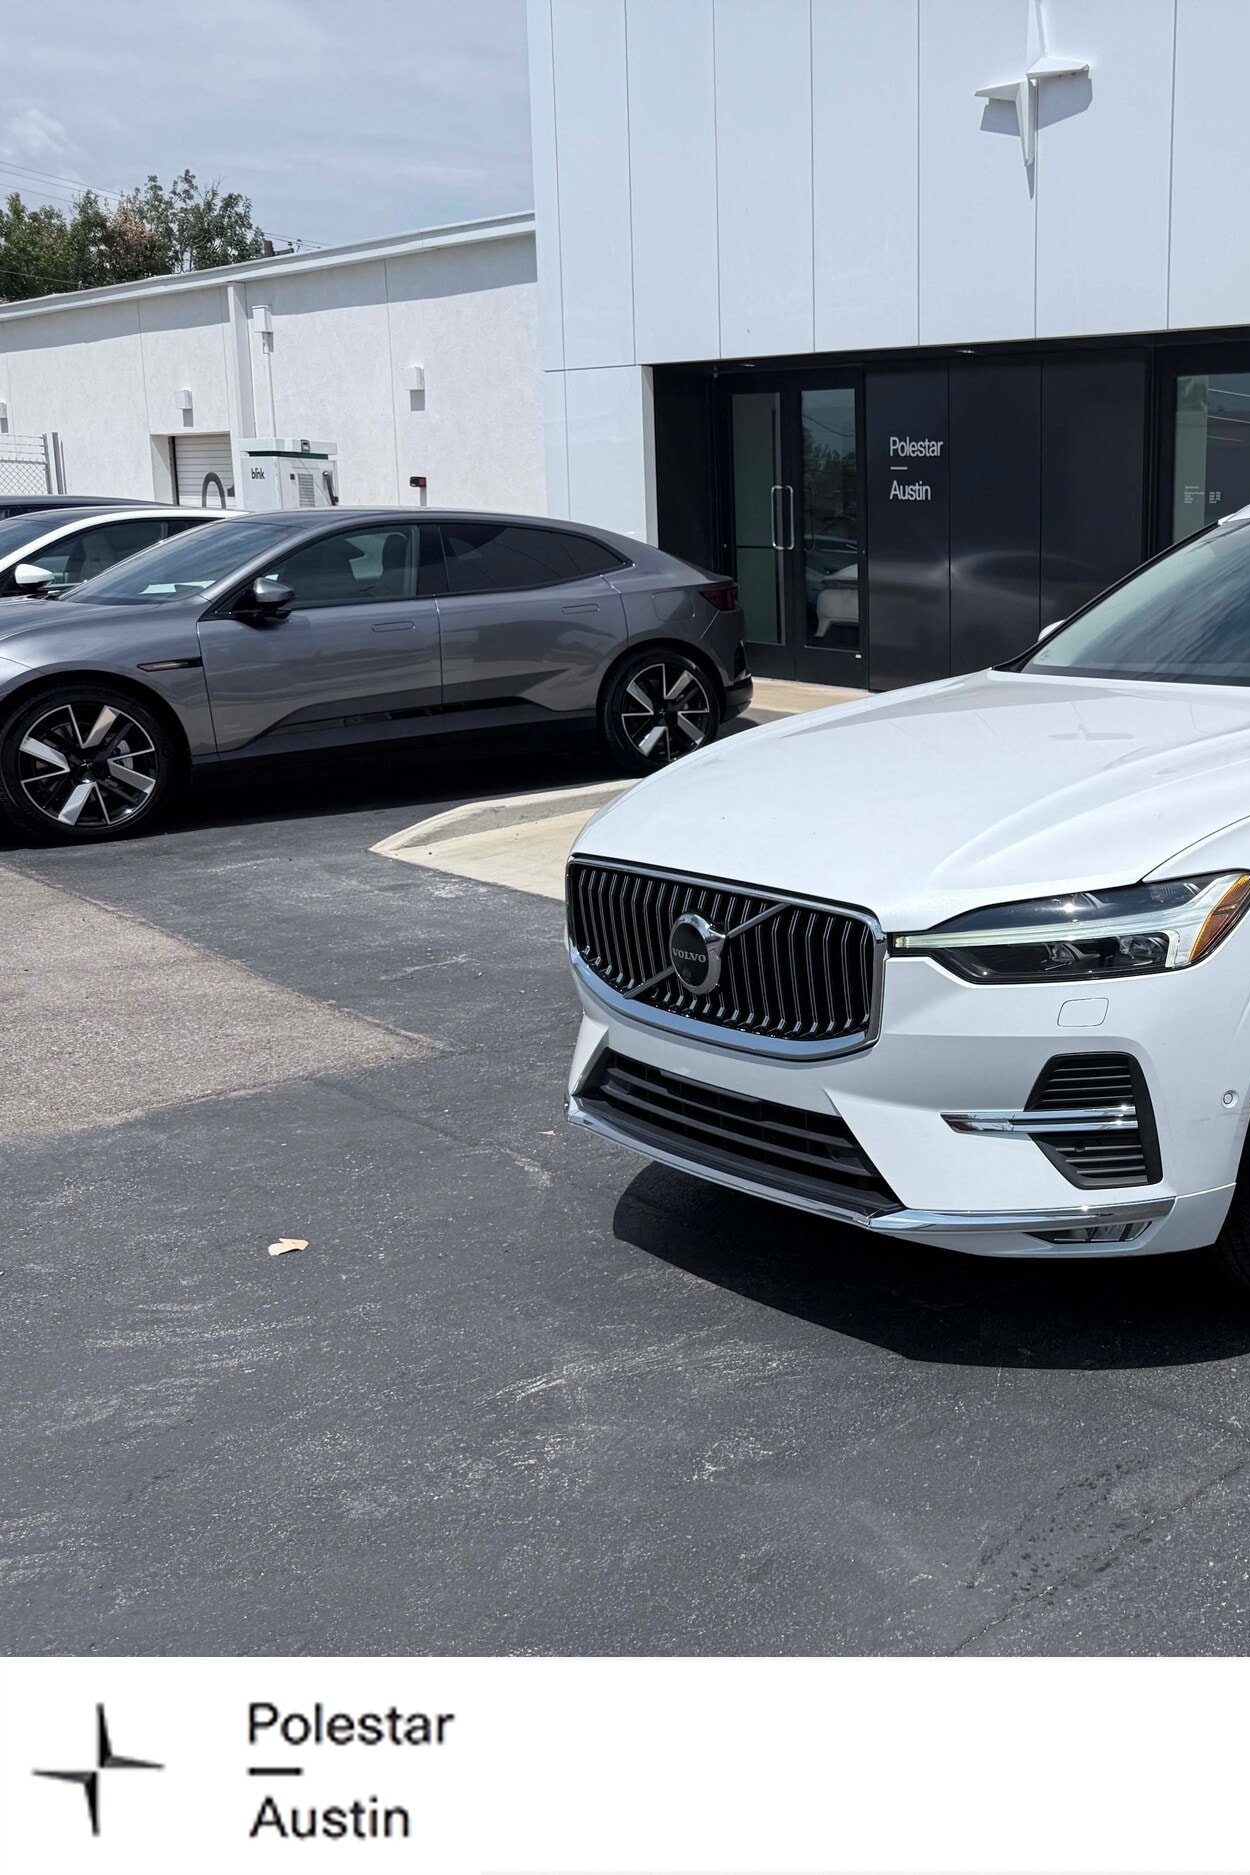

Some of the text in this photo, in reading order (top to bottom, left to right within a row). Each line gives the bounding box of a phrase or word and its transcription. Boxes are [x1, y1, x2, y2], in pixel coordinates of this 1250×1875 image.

[889, 436, 944, 457] Polestar
[889, 480, 932, 500] Austin
[671, 947, 707, 963] VOLVO
